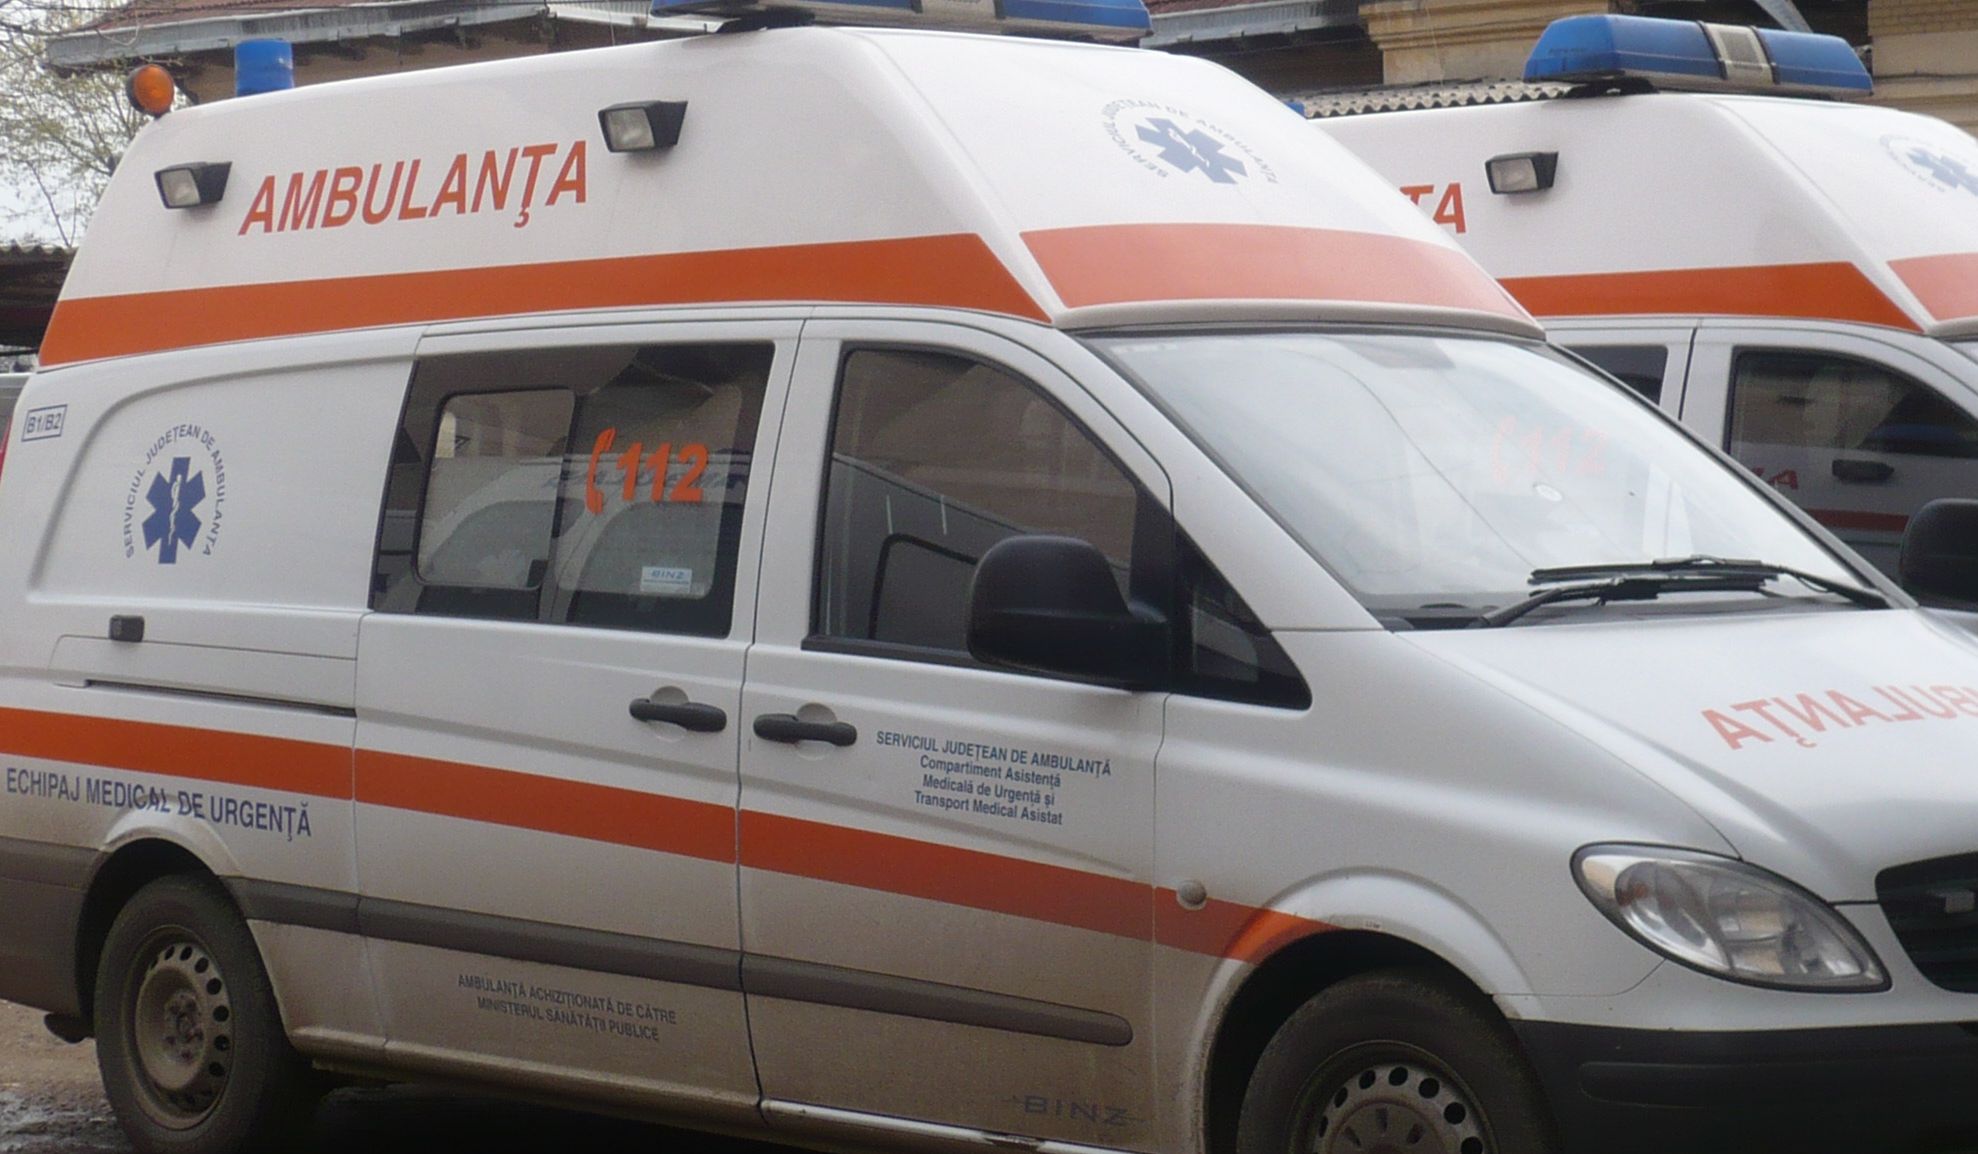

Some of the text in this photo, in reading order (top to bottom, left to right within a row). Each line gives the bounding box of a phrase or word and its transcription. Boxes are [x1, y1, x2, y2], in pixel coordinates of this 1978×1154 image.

[26, 412, 63, 434] B1/B2
[615, 441, 710, 504] 112
[123, 468, 147, 560] SERVICIUL
[200, 429, 216, 452] DE
[876, 730, 940, 752] SERVICIUL
[1010, 748, 1028, 765] DE
[919, 754, 1003, 780] Compartiment
[6, 767, 81, 802] ECHIPAJ
[86, 777, 172, 814] MEDICAL
[177, 790, 206, 819] DE
[914, 789, 1064, 826] Transport Medical Asistat
[976, 782, 992, 798] de
[476, 996, 545, 1022] MINISTERUL
[608, 1018, 660, 1042] PUBLICE
[616, 999, 634, 1018] DE
[1023, 1094, 1131, 1127] BINZ
